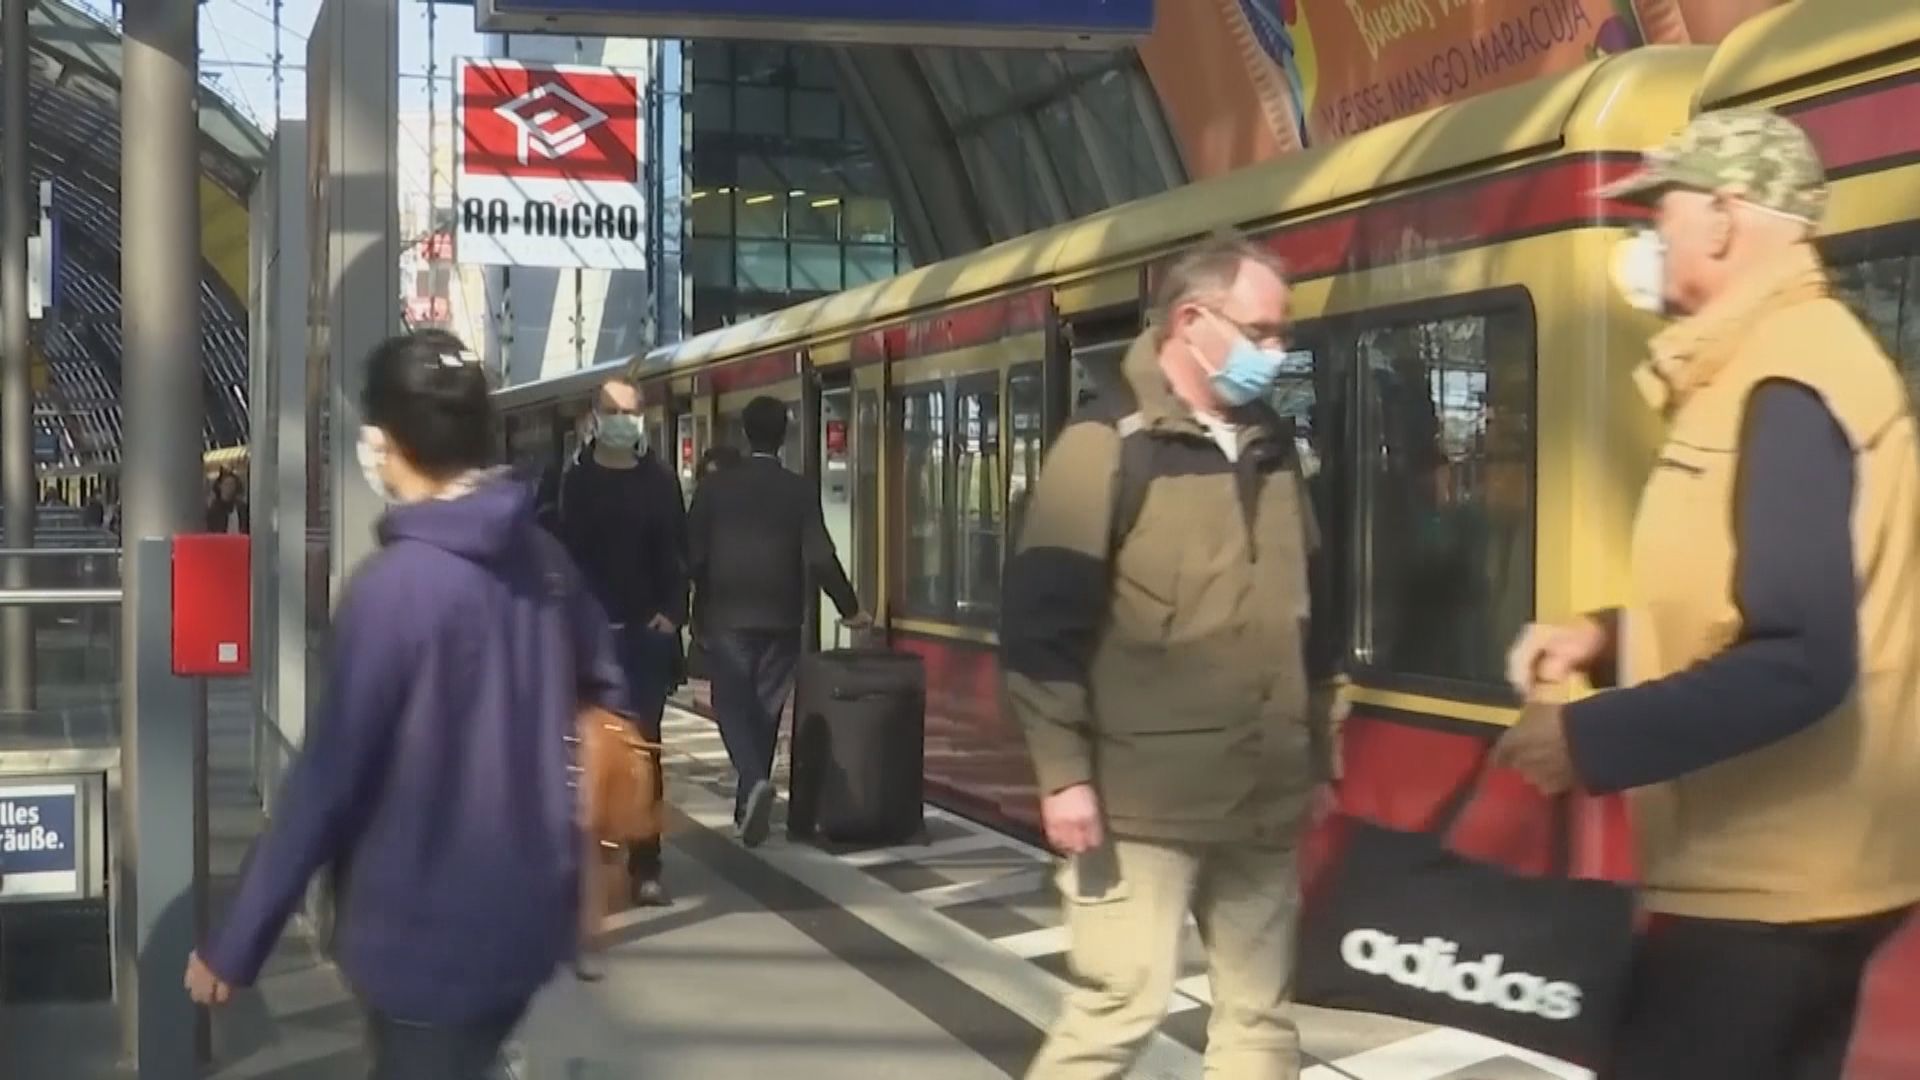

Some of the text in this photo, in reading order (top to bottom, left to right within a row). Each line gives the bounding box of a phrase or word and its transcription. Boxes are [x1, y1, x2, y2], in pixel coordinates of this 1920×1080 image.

[1321, 0, 1592, 136] WEISSE MANGO MARACUJA
[1345, 0, 1436, 62] Buenos
[1341, 928, 1582, 1020] adidas
